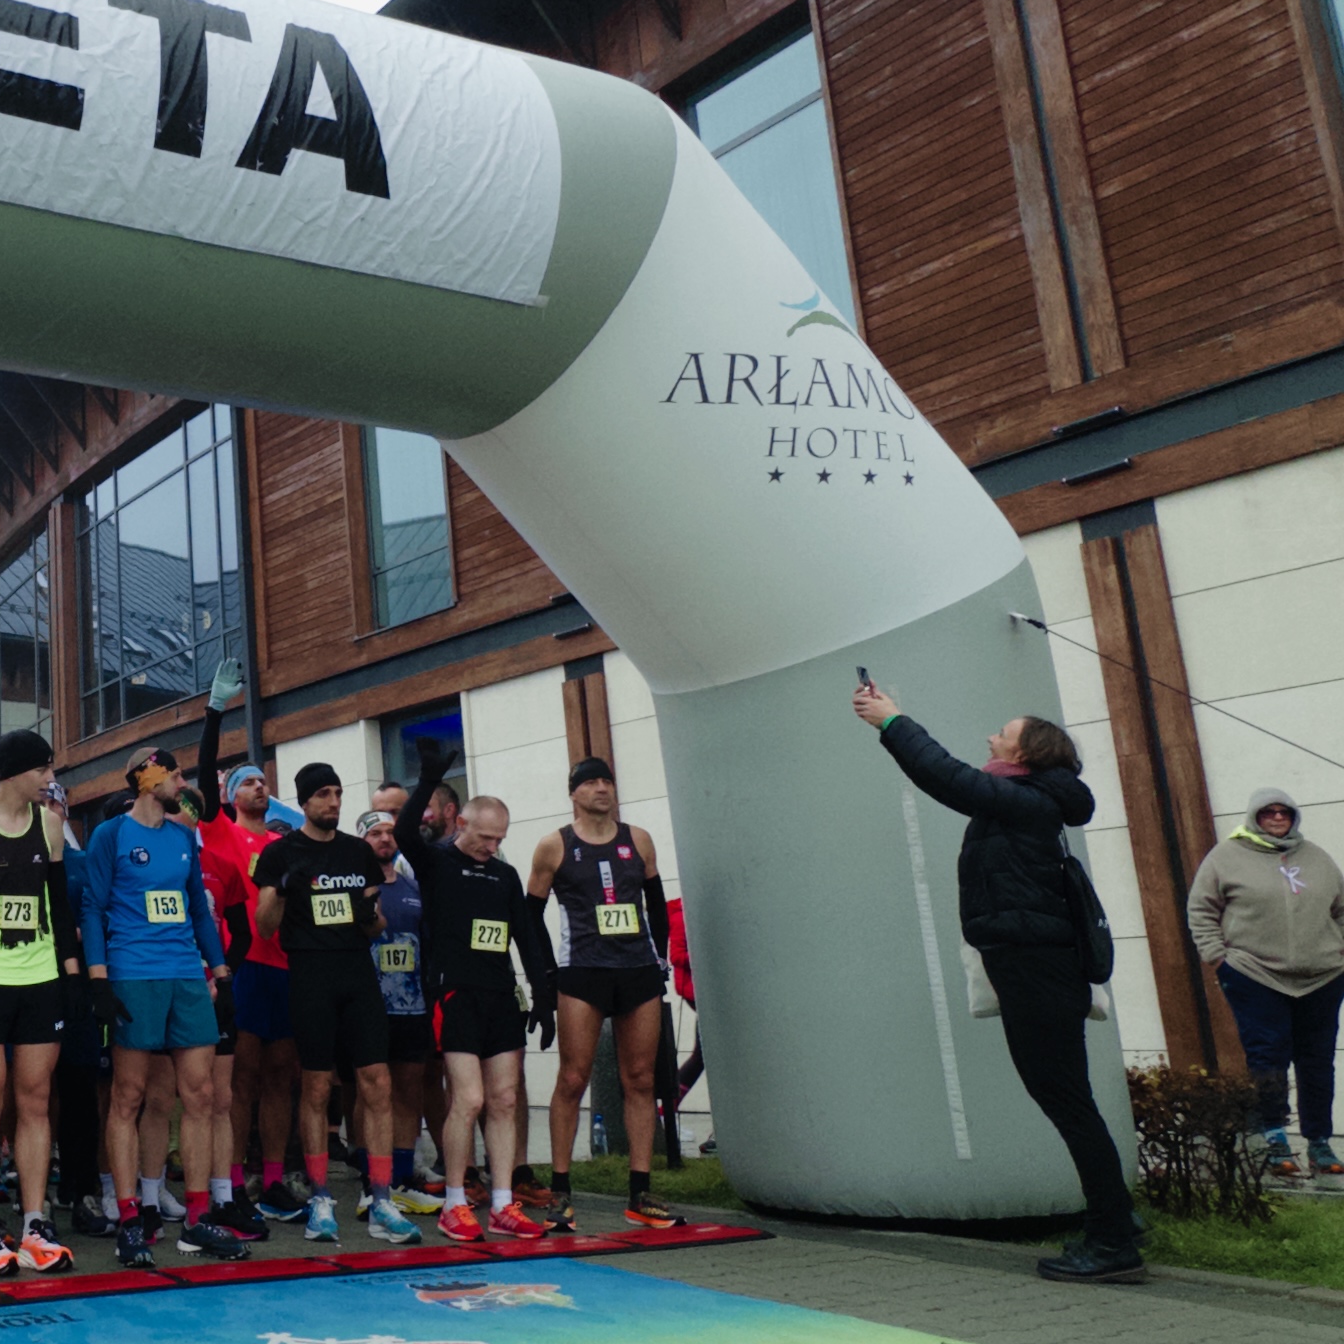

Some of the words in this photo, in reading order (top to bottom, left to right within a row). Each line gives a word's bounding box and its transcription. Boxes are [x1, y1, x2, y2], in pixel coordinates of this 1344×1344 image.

[763, 426, 916, 464] HOTEL
[317, 873, 366, 890] Gmoto
[4, 902, 31, 921] 273
[153, 897, 178, 915] 153
[319, 899, 345, 917] 204
[604, 910, 630, 927] 271
[478, 925, 502, 944] 272
[386, 949, 408, 966] 167
